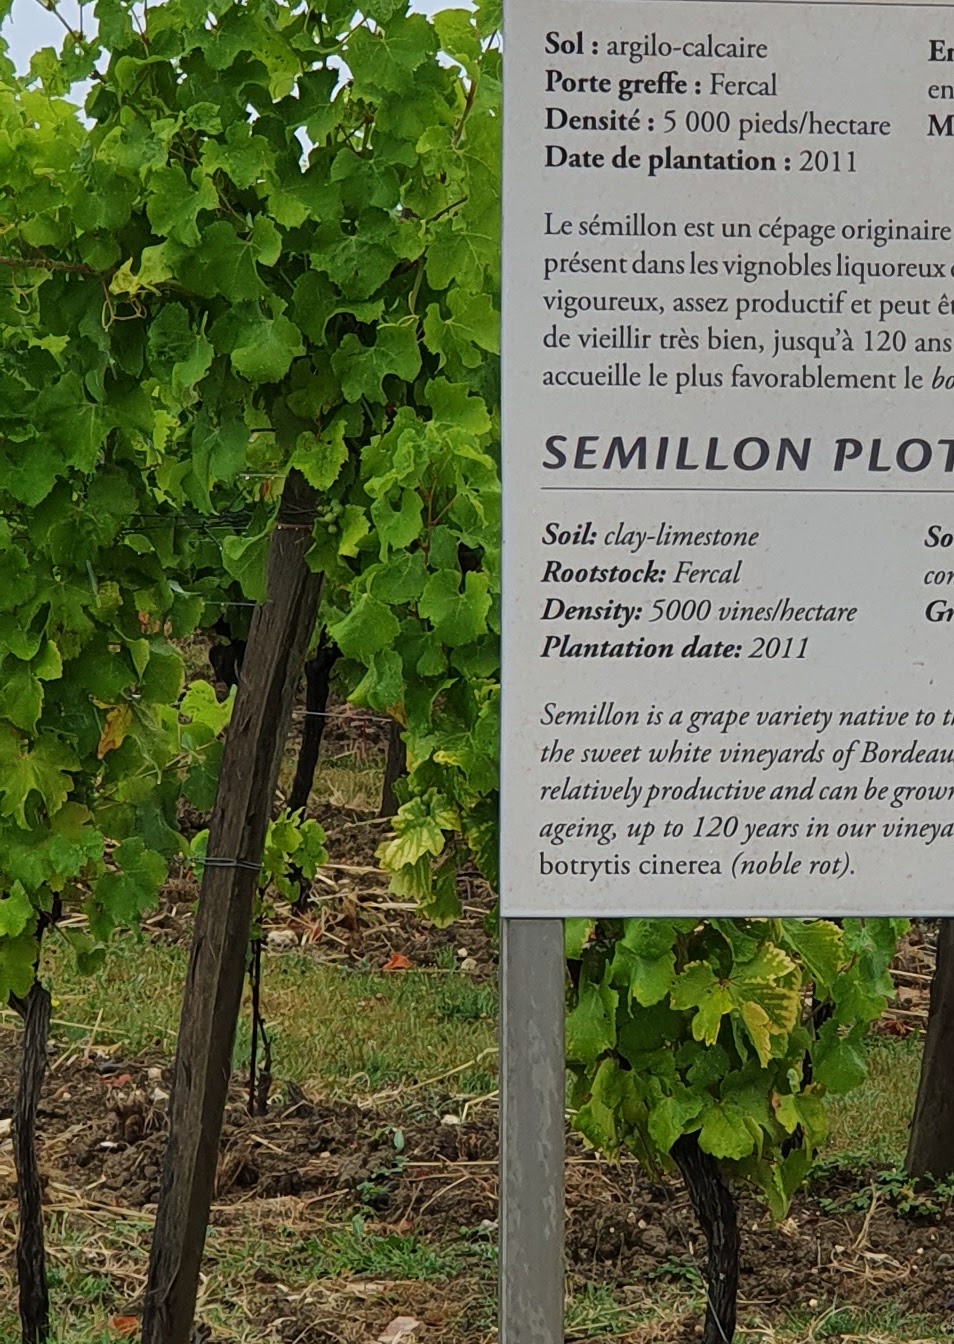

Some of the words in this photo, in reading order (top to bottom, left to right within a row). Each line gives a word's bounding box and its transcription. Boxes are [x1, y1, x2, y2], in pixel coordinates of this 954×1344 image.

[544, 32, 583, 54] Sol
[606, 33, 767, 64] argilo-calcaire
[545, 70, 611, 92] Porte
[618, 71, 687, 101] greffe
[709, 73, 776, 95] Fercal
[544, 108, 640, 131] Densité
[663, 110, 676, 133] 5
[685, 111, 730, 132] 000
[739, 110, 890, 140] pieds/hectare
[544, 145, 604, 168] Date
[611, 145, 640, 168] de
[648, 146, 776, 177] plantation
[799, 150, 855, 172] 2011
[544, 213, 572, 235] Le
[578, 213, 676, 236] sémillon
[684, 221, 714, 238] est
[721, 222, 751, 238] un
[758, 217, 835, 246] cépage
[841, 219, 951, 247] originaire
[544, 251, 627, 280] présent
[631, 251, 684, 274] dans
[689, 252, 718, 274] les
[722, 253, 831, 283] vignobles
[836, 253, 945, 284] liquoreux
[542, 289, 664, 318] vigoureux,
[673, 297, 728, 313] assez
[736, 290, 844, 320] productif
[850, 298, 871, 315] et
[879, 299, 930, 322] peut
[542, 363, 640, 386] accueille
[648, 363, 668, 386] le
[674, 363, 723, 394] plus
[730, 364, 896, 389] favorablement
[903, 366, 923, 389] le
[542, 435, 811, 471] SEMILLON
[541, 522, 597, 545] Soil:
[603, 522, 759, 553] clay-limestone
[540, 560, 666, 583] Rootstock:
[672, 560, 742, 583] Fercal
[539, 598, 642, 628] Density:
[648, 599, 711, 622] 5000
[718, 598, 857, 621] vines/hectare
[539, 635, 673, 657] Plantation
[680, 635, 742, 658] date:
[747, 637, 808, 658] 2011
[540, 739, 575, 762] the
[580, 745, 642, 763] sweet
[648, 739, 712, 763] white
[719, 740, 825, 770] vineyards
[831, 740, 858, 771] of
[538, 817, 616, 845] ageing,
[627, 822, 655, 845] up
[663, 820, 683, 838] to
[692, 816, 738, 837] 120
[740, 823, 799, 845] years
[805, 817, 829, 837] in
[836, 823, 876, 838] our
